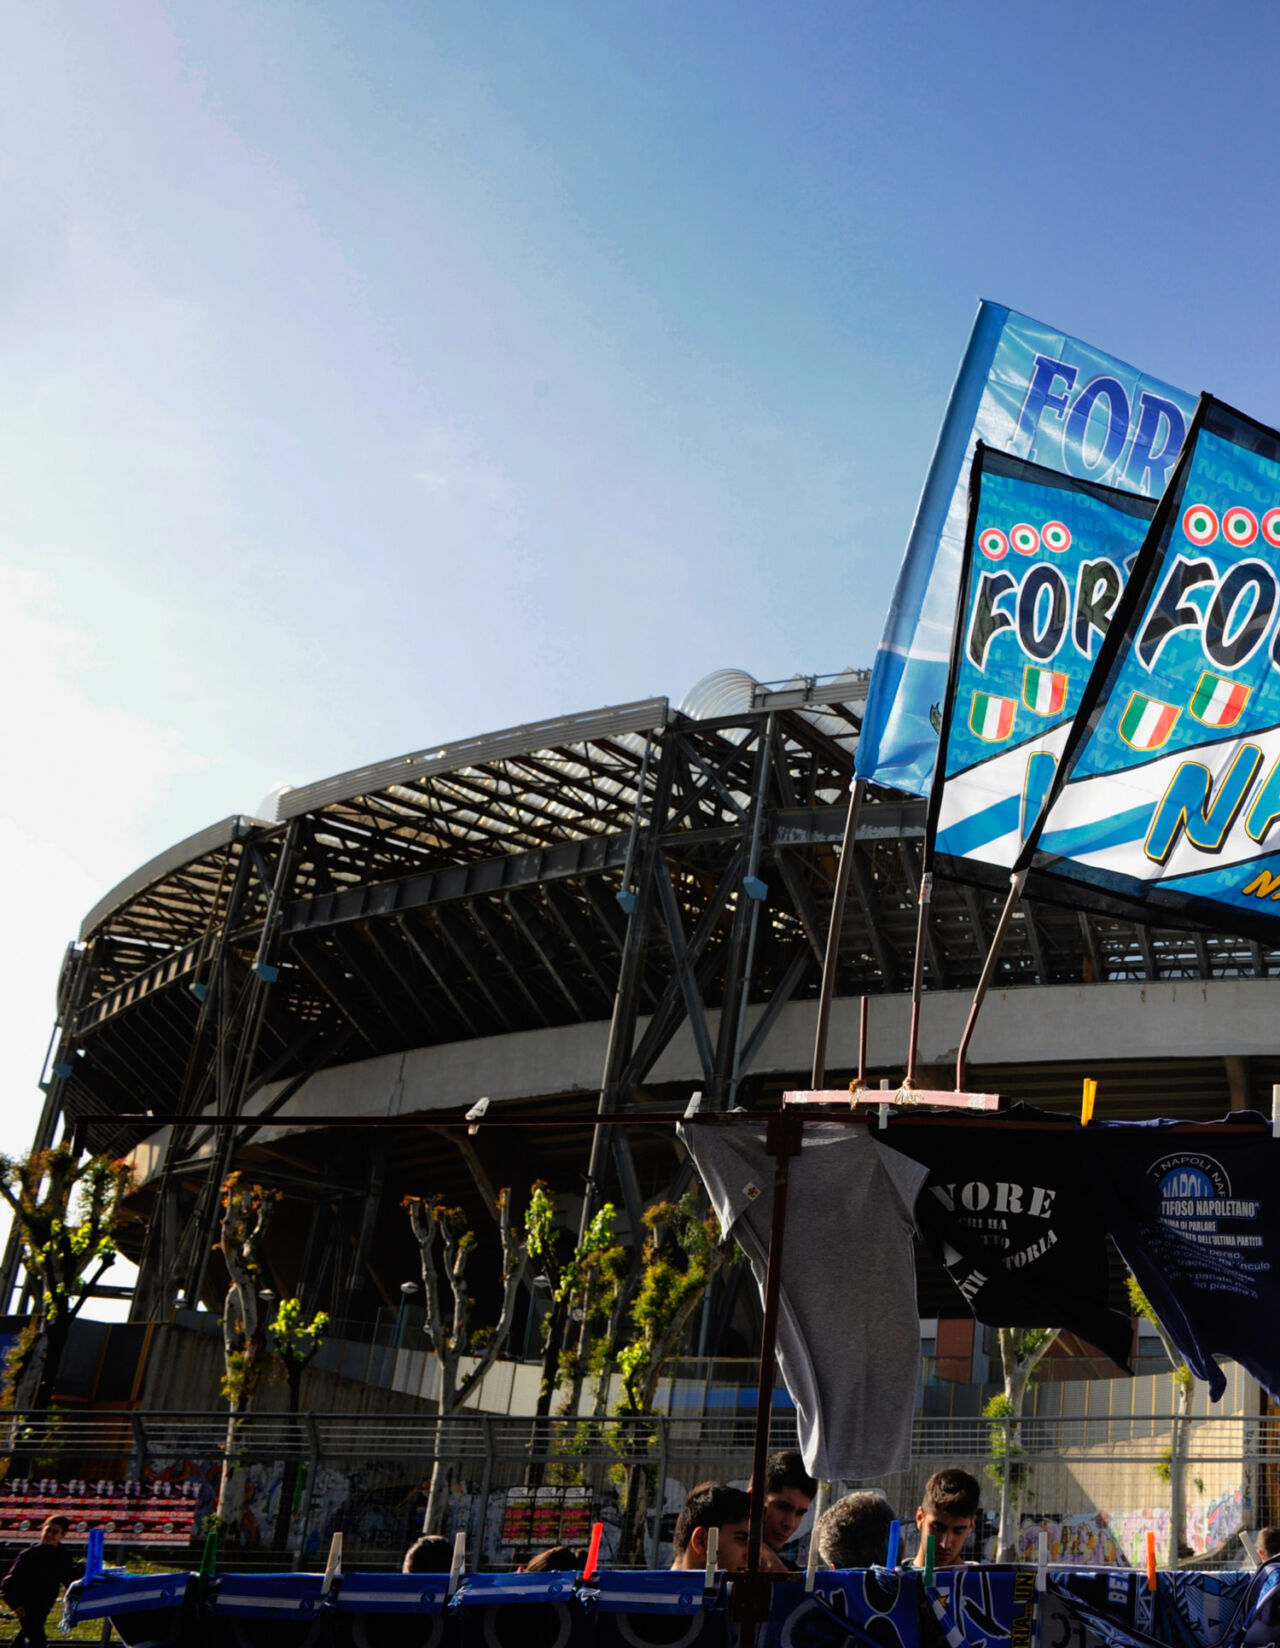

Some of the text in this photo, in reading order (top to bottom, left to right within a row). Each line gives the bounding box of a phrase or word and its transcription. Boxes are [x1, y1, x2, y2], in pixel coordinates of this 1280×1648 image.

[1160, 1157, 1213, 1172] NAPOLI
[1161, 1200, 1194, 1215] TIFOSO
[987, 1218, 1009, 1232] HA
[1188, 1221, 1217, 1232] PARLARE
